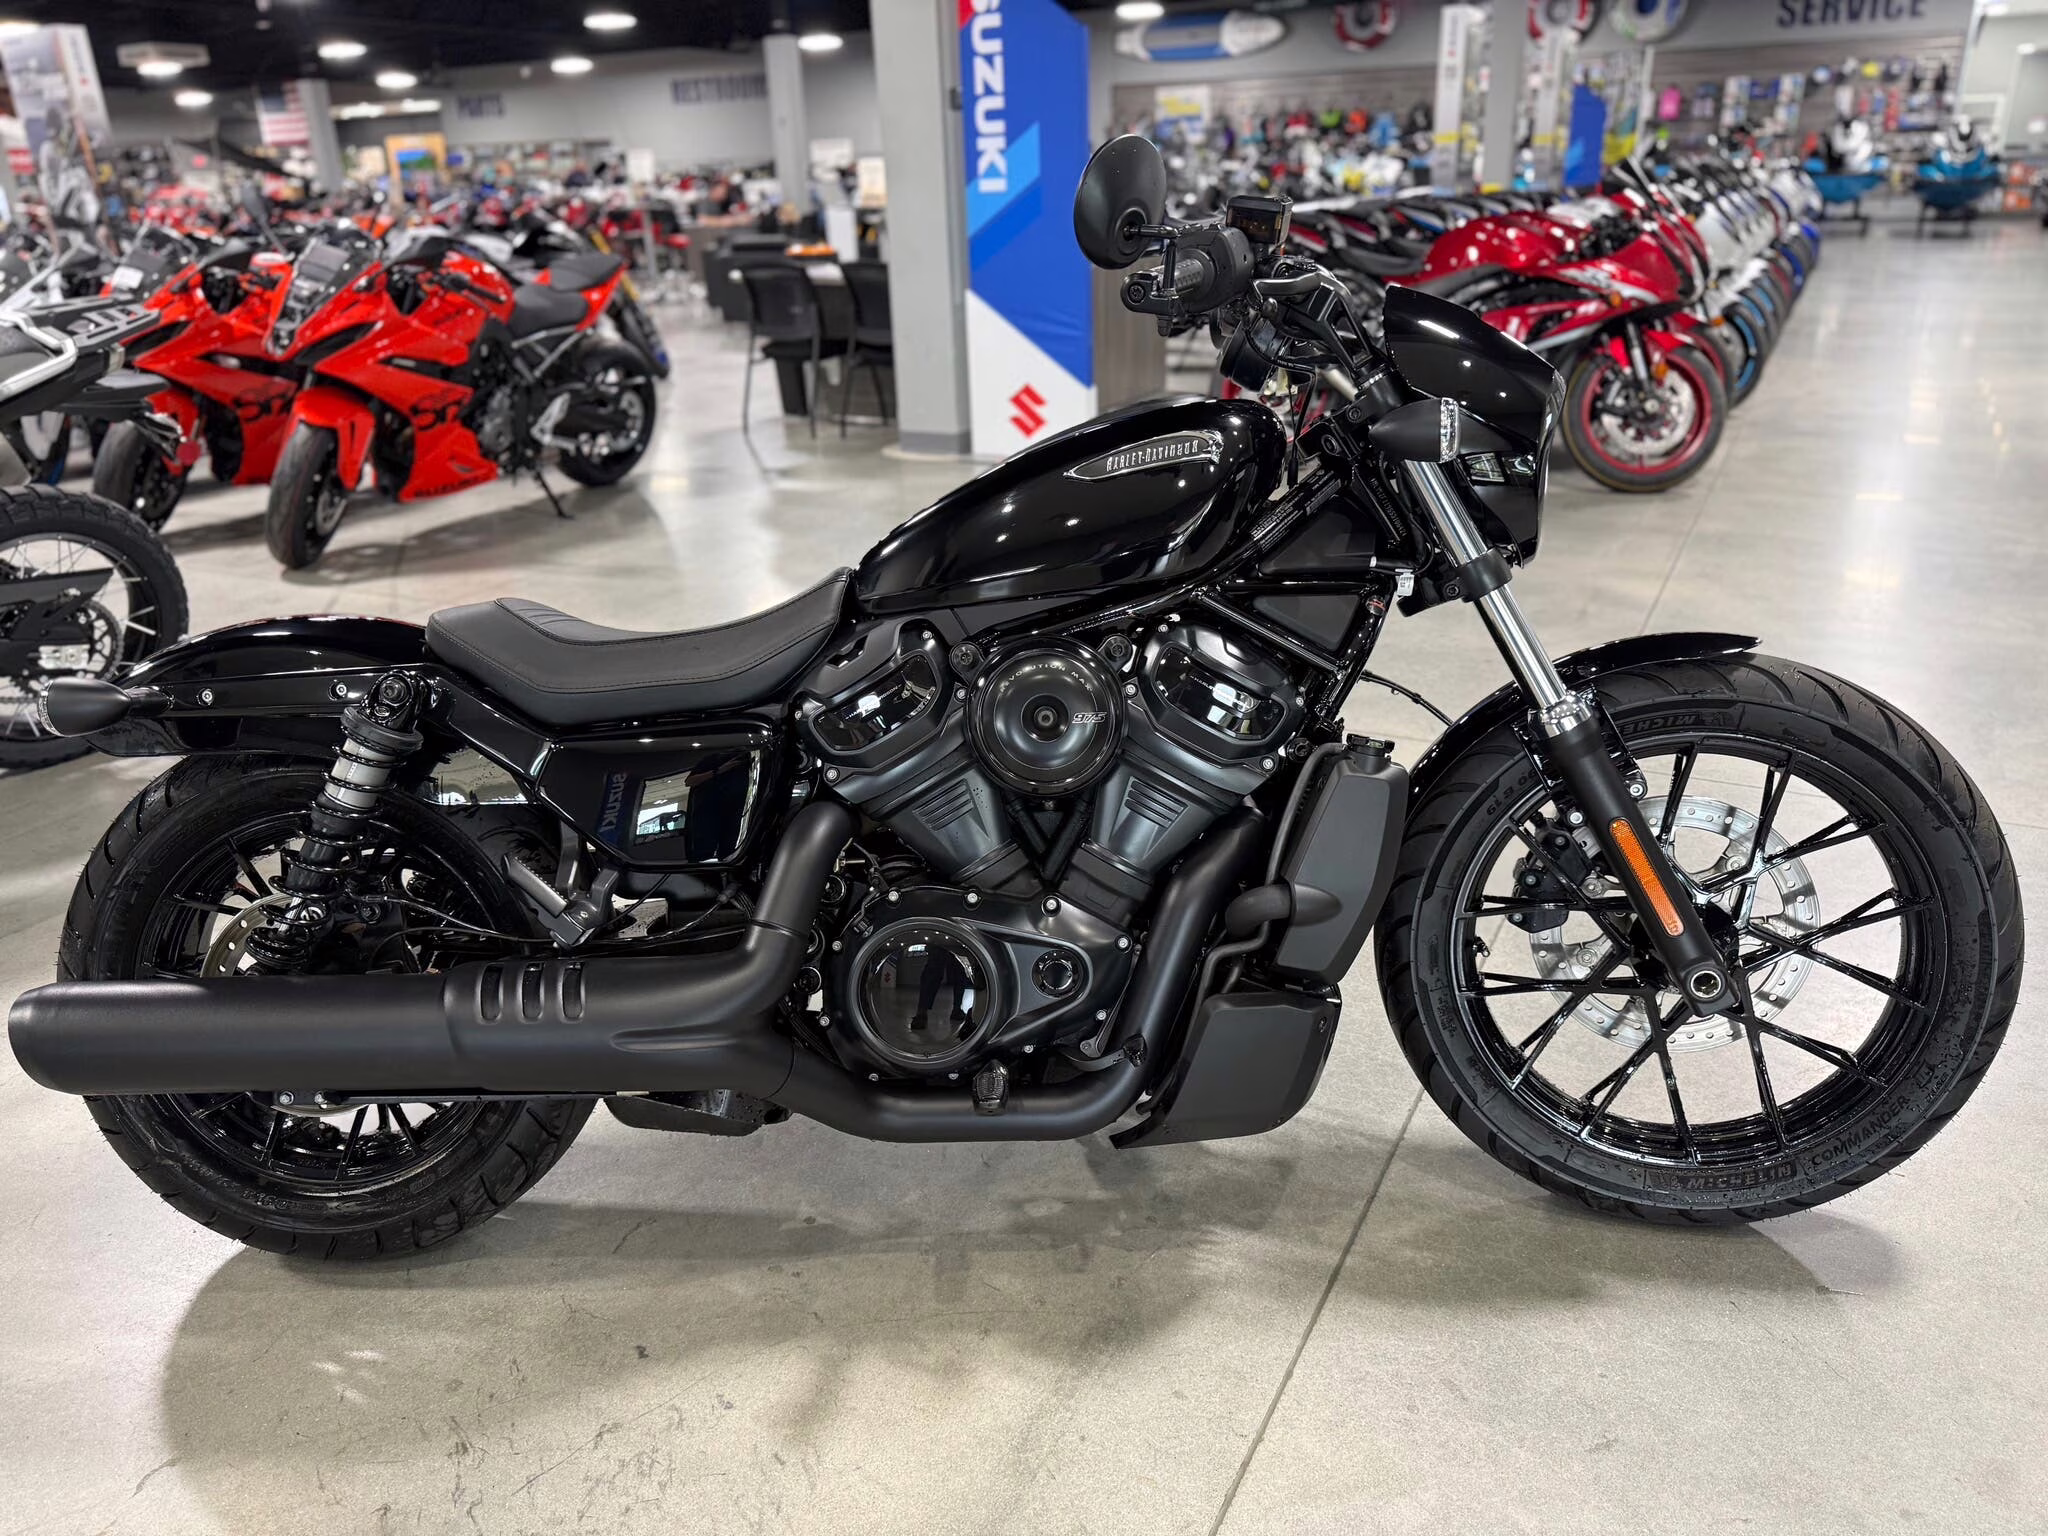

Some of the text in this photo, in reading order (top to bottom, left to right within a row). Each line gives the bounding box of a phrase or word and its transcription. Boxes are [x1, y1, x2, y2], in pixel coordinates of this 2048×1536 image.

[1777, 0, 1927, 29] SERVICE
[1106, 439, 1199, 472] HARLEY-DAVIDSON
[1072, 711, 1108, 724] 975
[1811, 1096, 1910, 1166] COMMANDER
